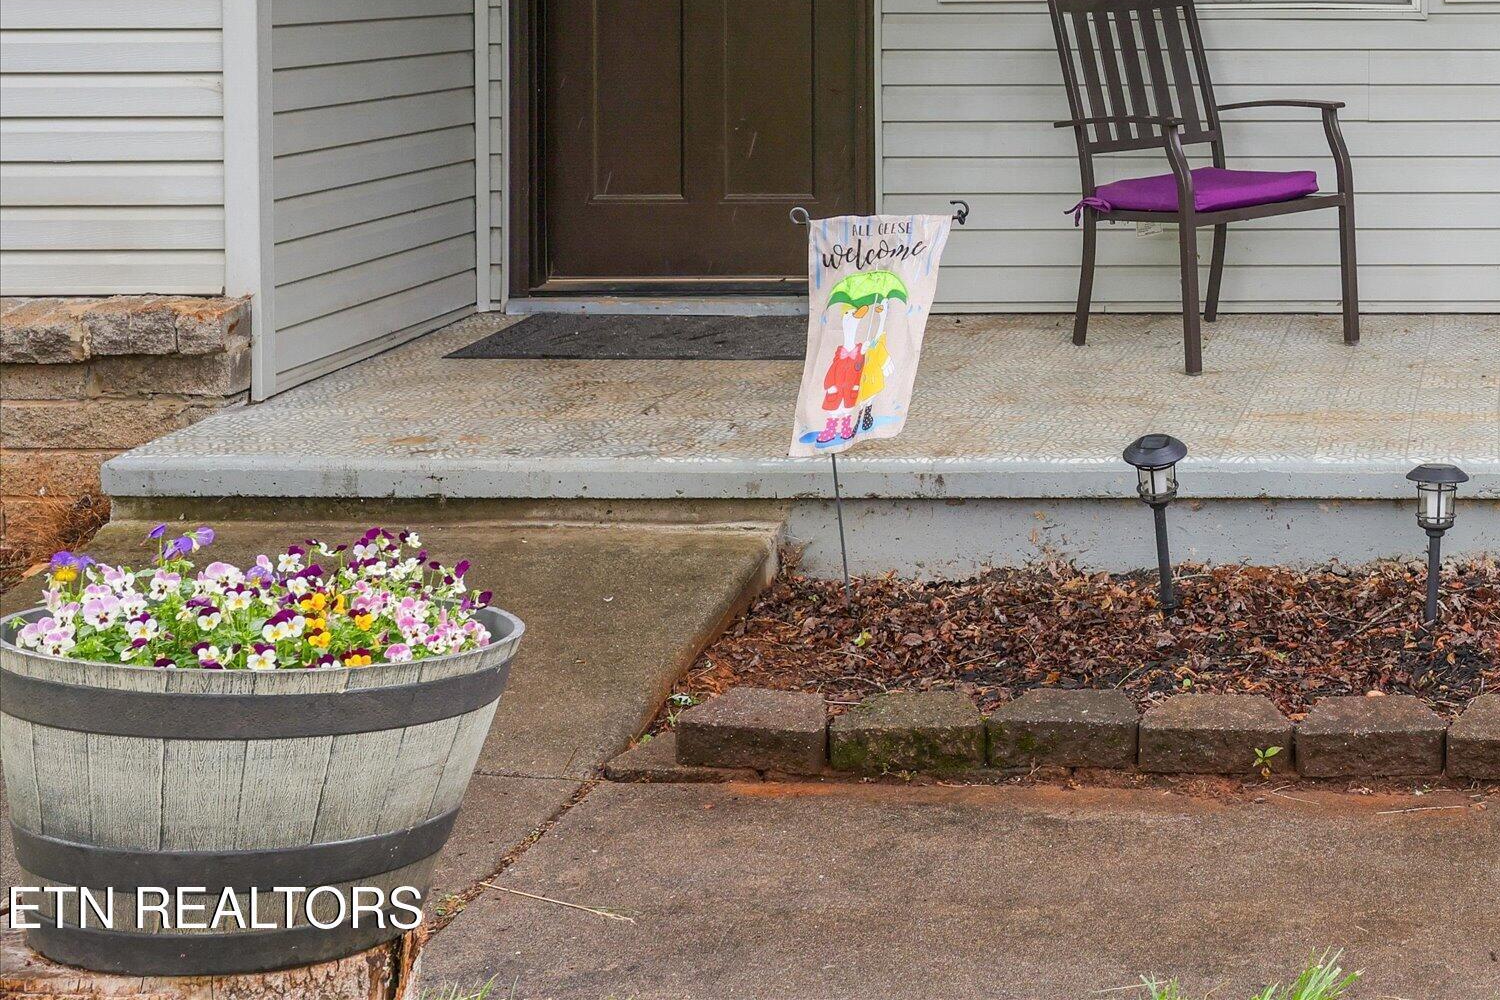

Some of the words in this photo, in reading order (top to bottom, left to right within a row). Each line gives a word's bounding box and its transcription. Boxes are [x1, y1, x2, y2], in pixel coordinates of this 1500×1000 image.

[852, 224, 873, 237] ALL
[878, 221, 913, 236] GEESE
[822, 238, 927, 271] welcome
